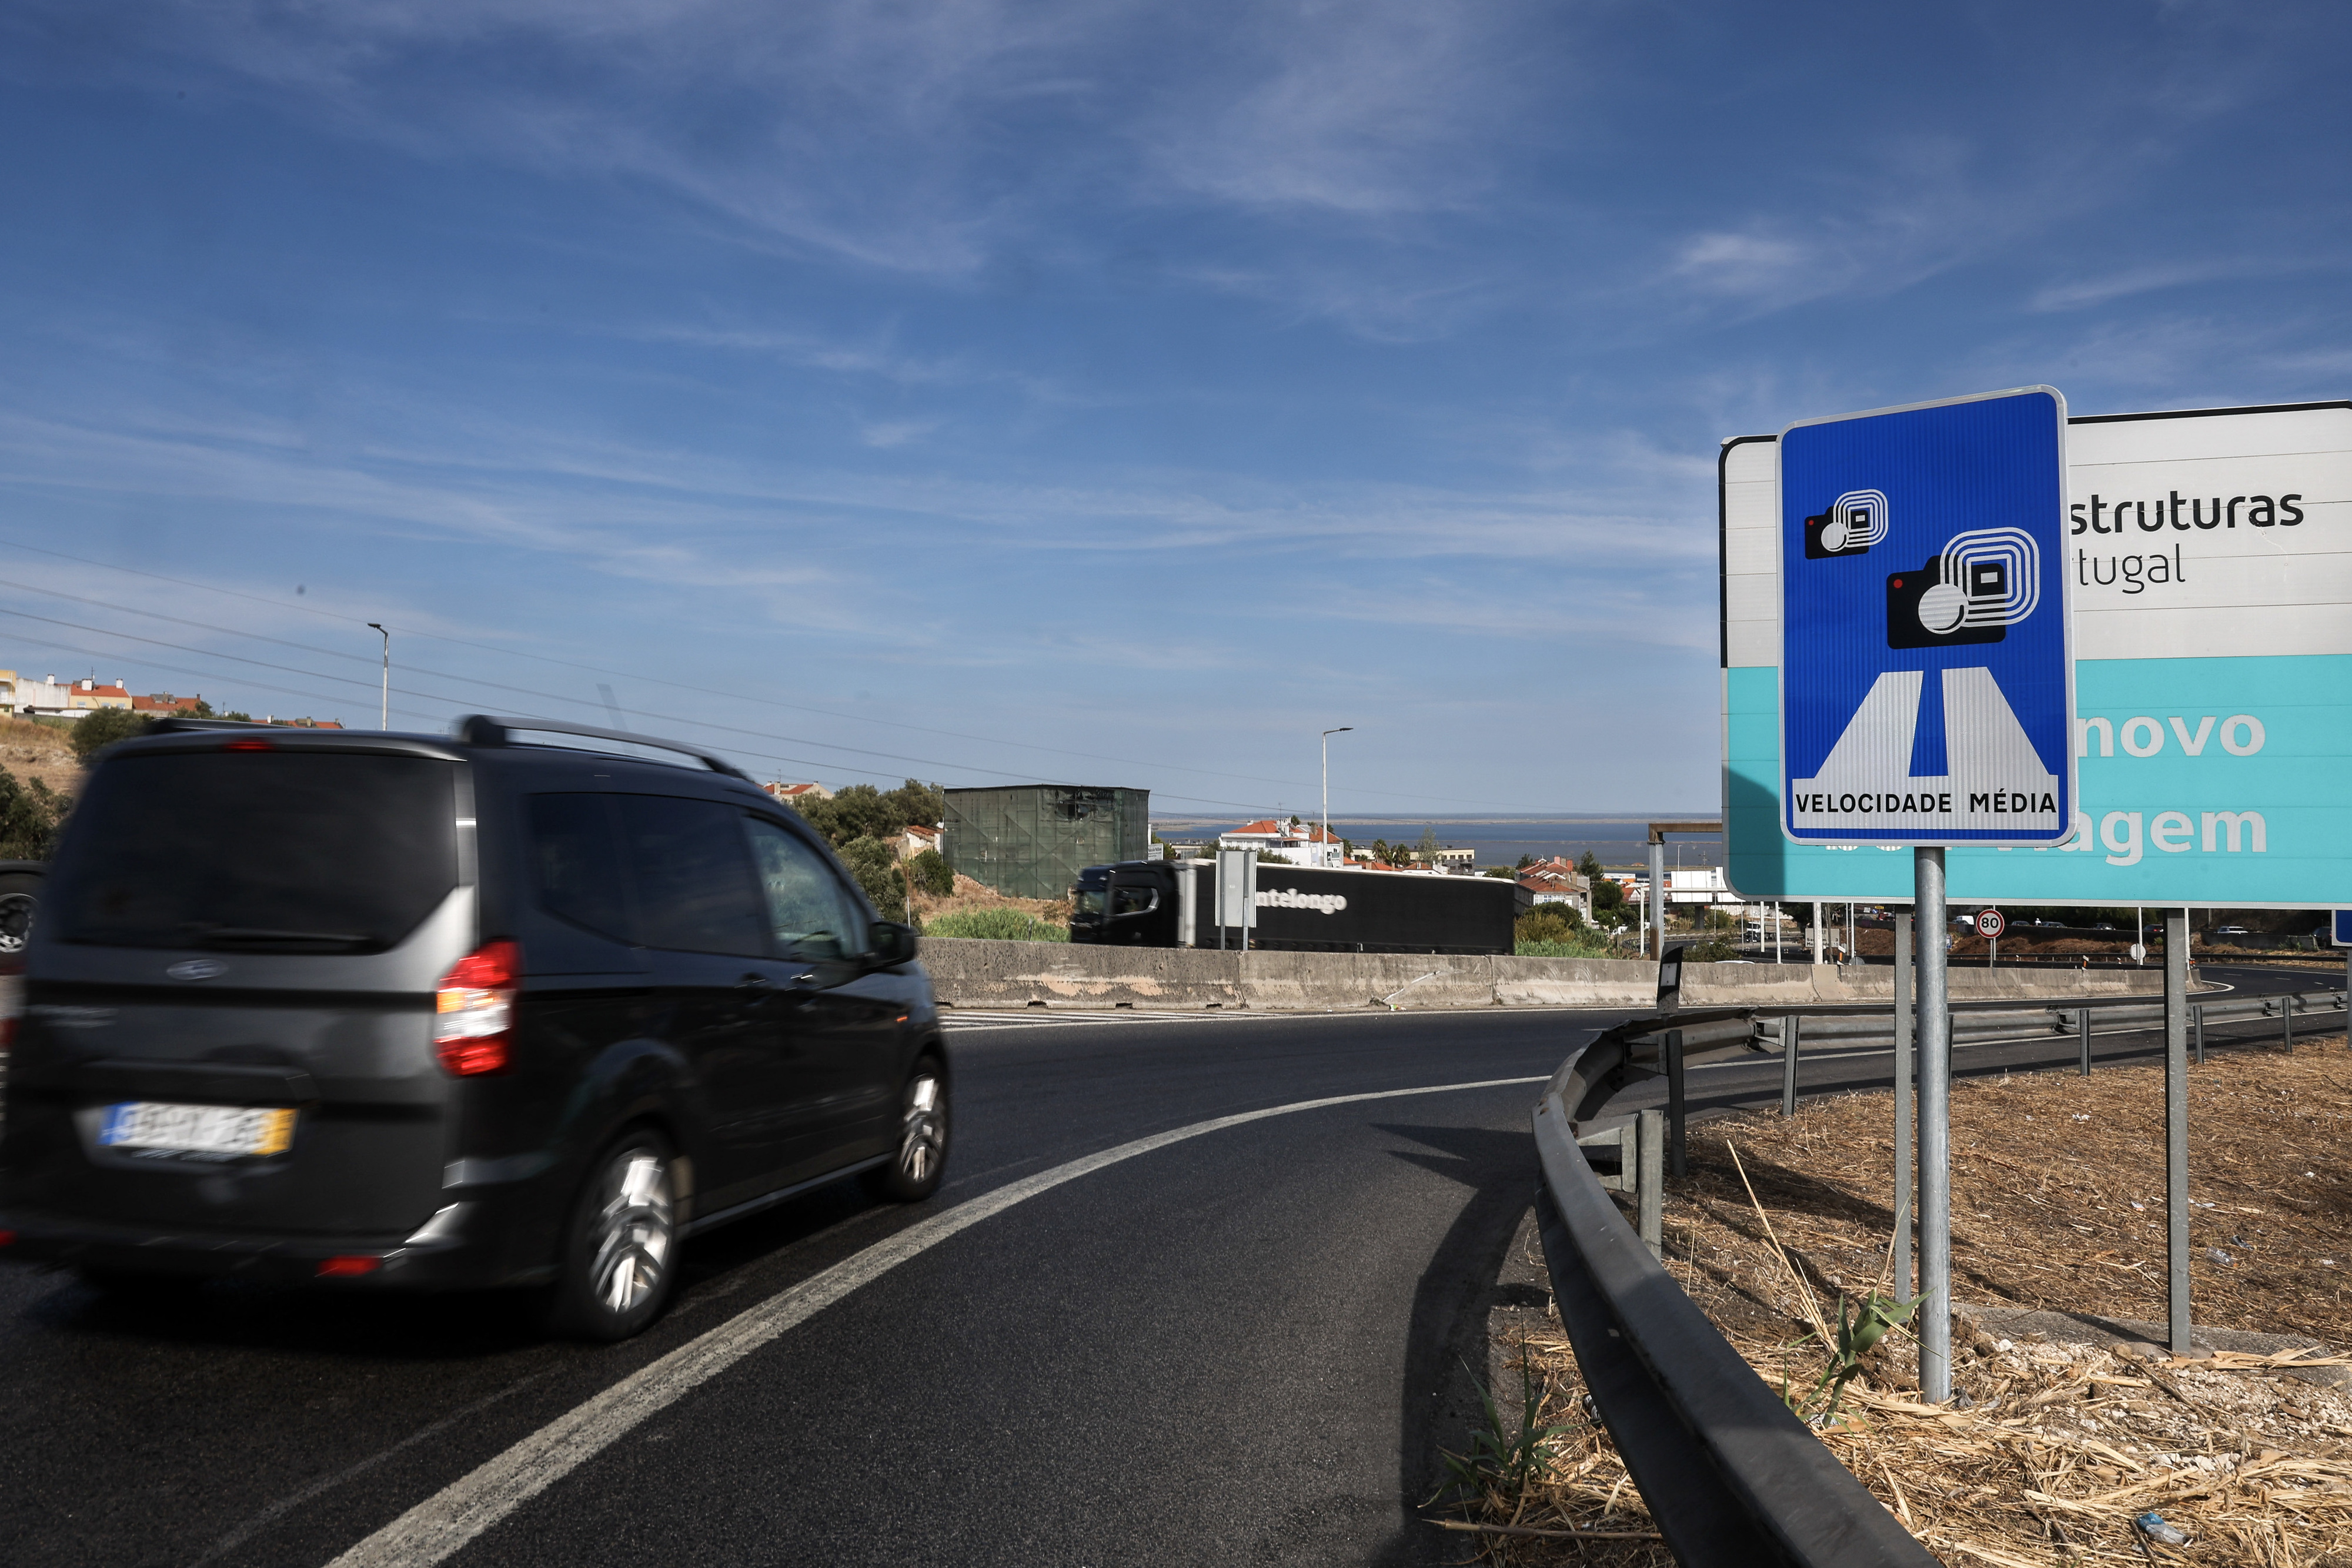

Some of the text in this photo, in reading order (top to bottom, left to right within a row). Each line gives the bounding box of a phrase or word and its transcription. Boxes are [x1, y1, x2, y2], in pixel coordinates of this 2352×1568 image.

[2071, 490, 2304, 535] struturas
[2072, 543, 2186, 594] tugal
[2077, 714, 2266, 758] novo
[1796, 788, 2057, 813] VELOCIDADE MÉDIA
[1997, 810, 2267, 867] agem
[1981, 917, 1999, 928] 80
